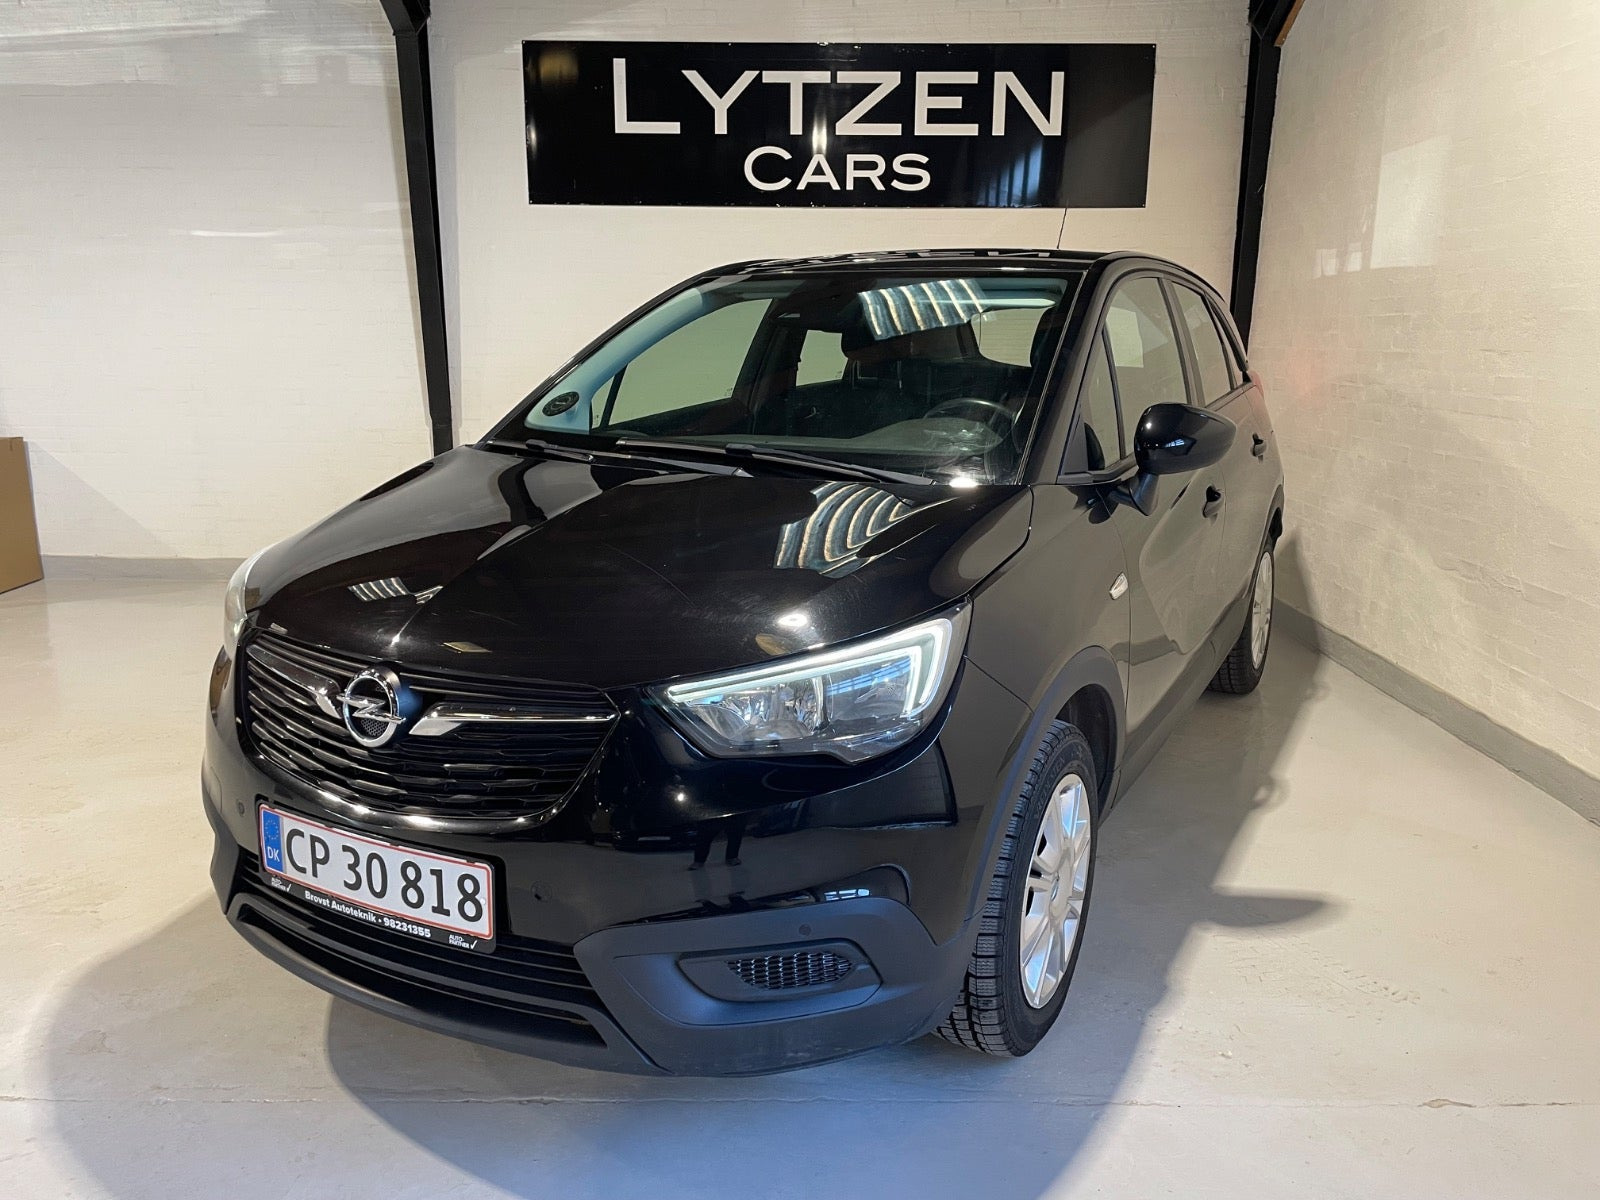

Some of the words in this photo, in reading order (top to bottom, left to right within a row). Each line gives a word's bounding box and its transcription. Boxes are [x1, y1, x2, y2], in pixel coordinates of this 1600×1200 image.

[613, 58, 1065, 136] LYTZEN
[743, 145, 931, 191] CARS
[267, 846, 280, 862] DK
[286, 828, 330, 879] CP
[341, 844, 388, 899] 30
[400, 860, 483, 923] 818
[304, 890, 330, 907] Brovst
[331, 901, 376, 923] Autoteknik
[383, 917, 431, 938] 98231355
